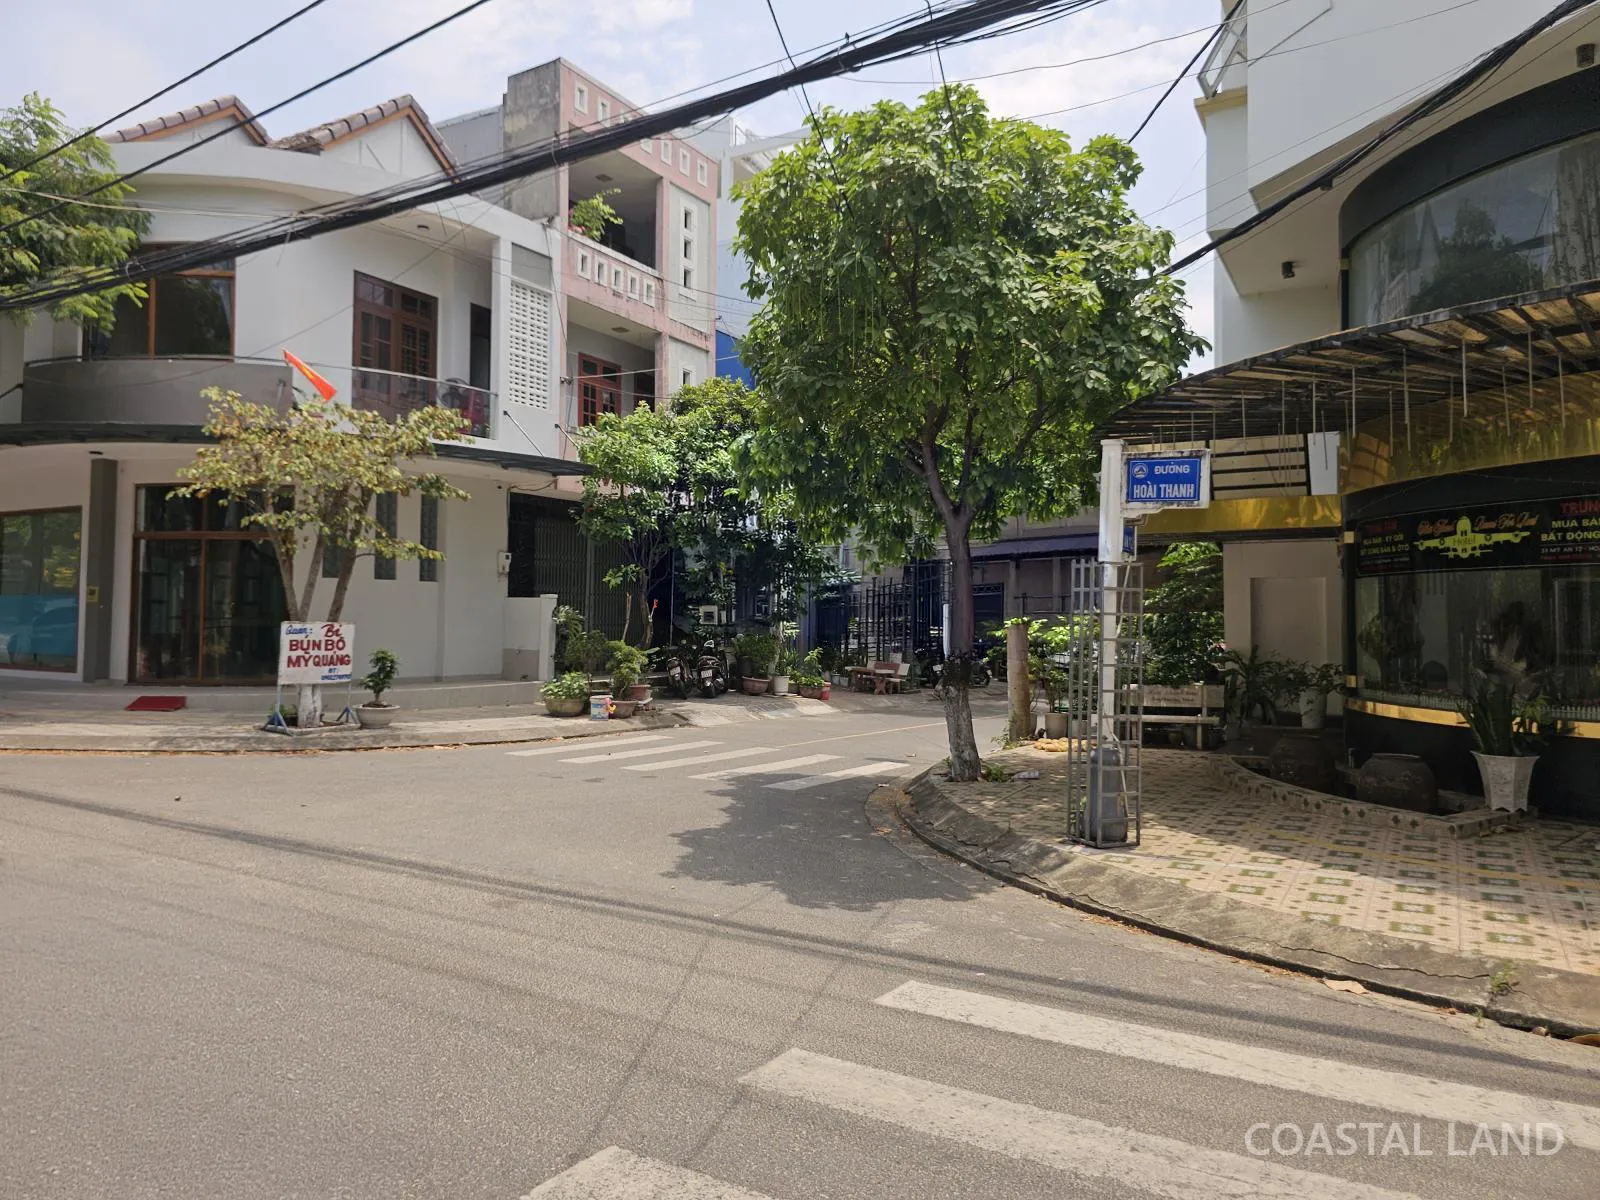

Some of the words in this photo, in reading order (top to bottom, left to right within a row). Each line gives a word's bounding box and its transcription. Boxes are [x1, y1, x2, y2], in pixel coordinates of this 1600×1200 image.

[1133, 481, 1157, 498] HOÀI
[1159, 484, 1194, 498] THANH
[1551, 519, 1578, 529] MUA
